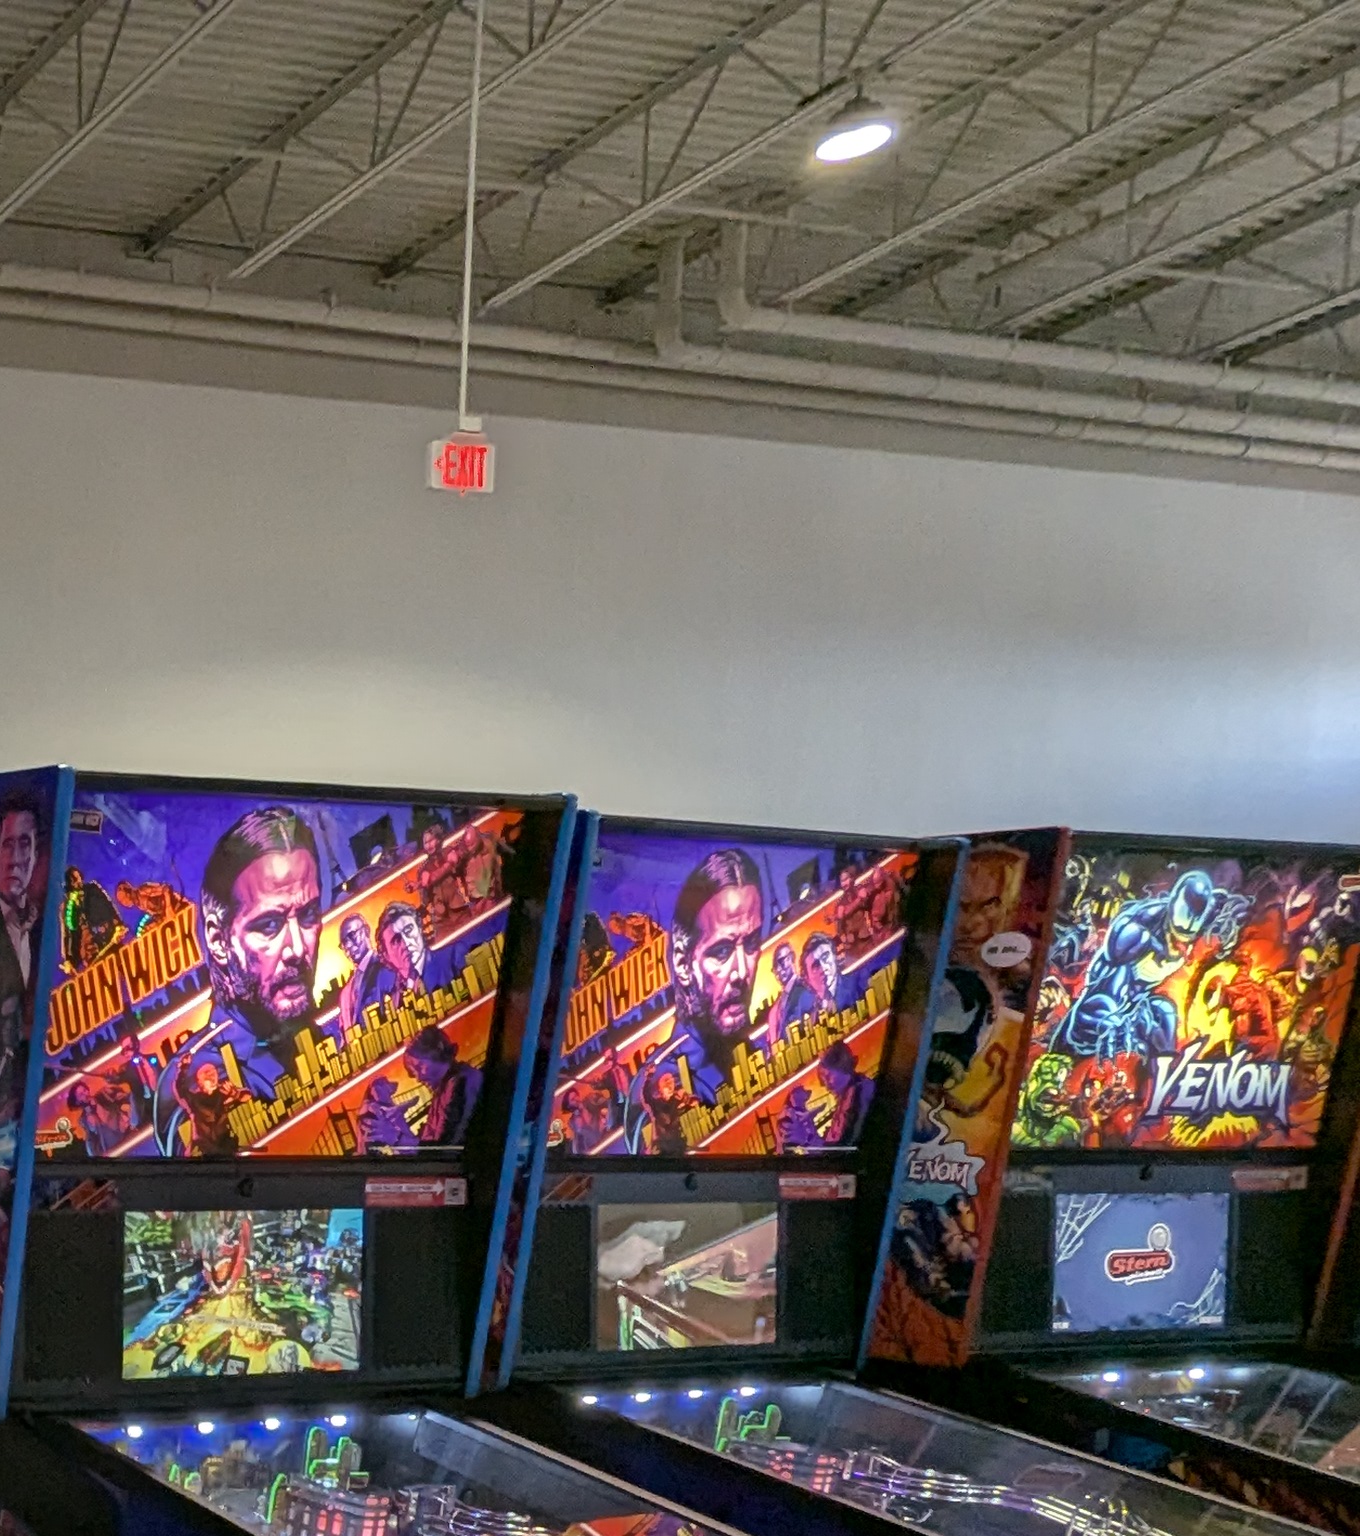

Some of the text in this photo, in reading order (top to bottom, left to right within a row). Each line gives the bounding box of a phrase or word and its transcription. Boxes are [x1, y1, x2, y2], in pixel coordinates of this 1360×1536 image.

[442, 444, 488, 488] EXIT
[116, 903, 205, 1007] WICK
[613, 934, 672, 1022] WICK
[43, 960, 128, 1054] JOHN
[1146, 1041, 1293, 1126] VENOM
[1111, 1252, 1169, 1276] Stern
